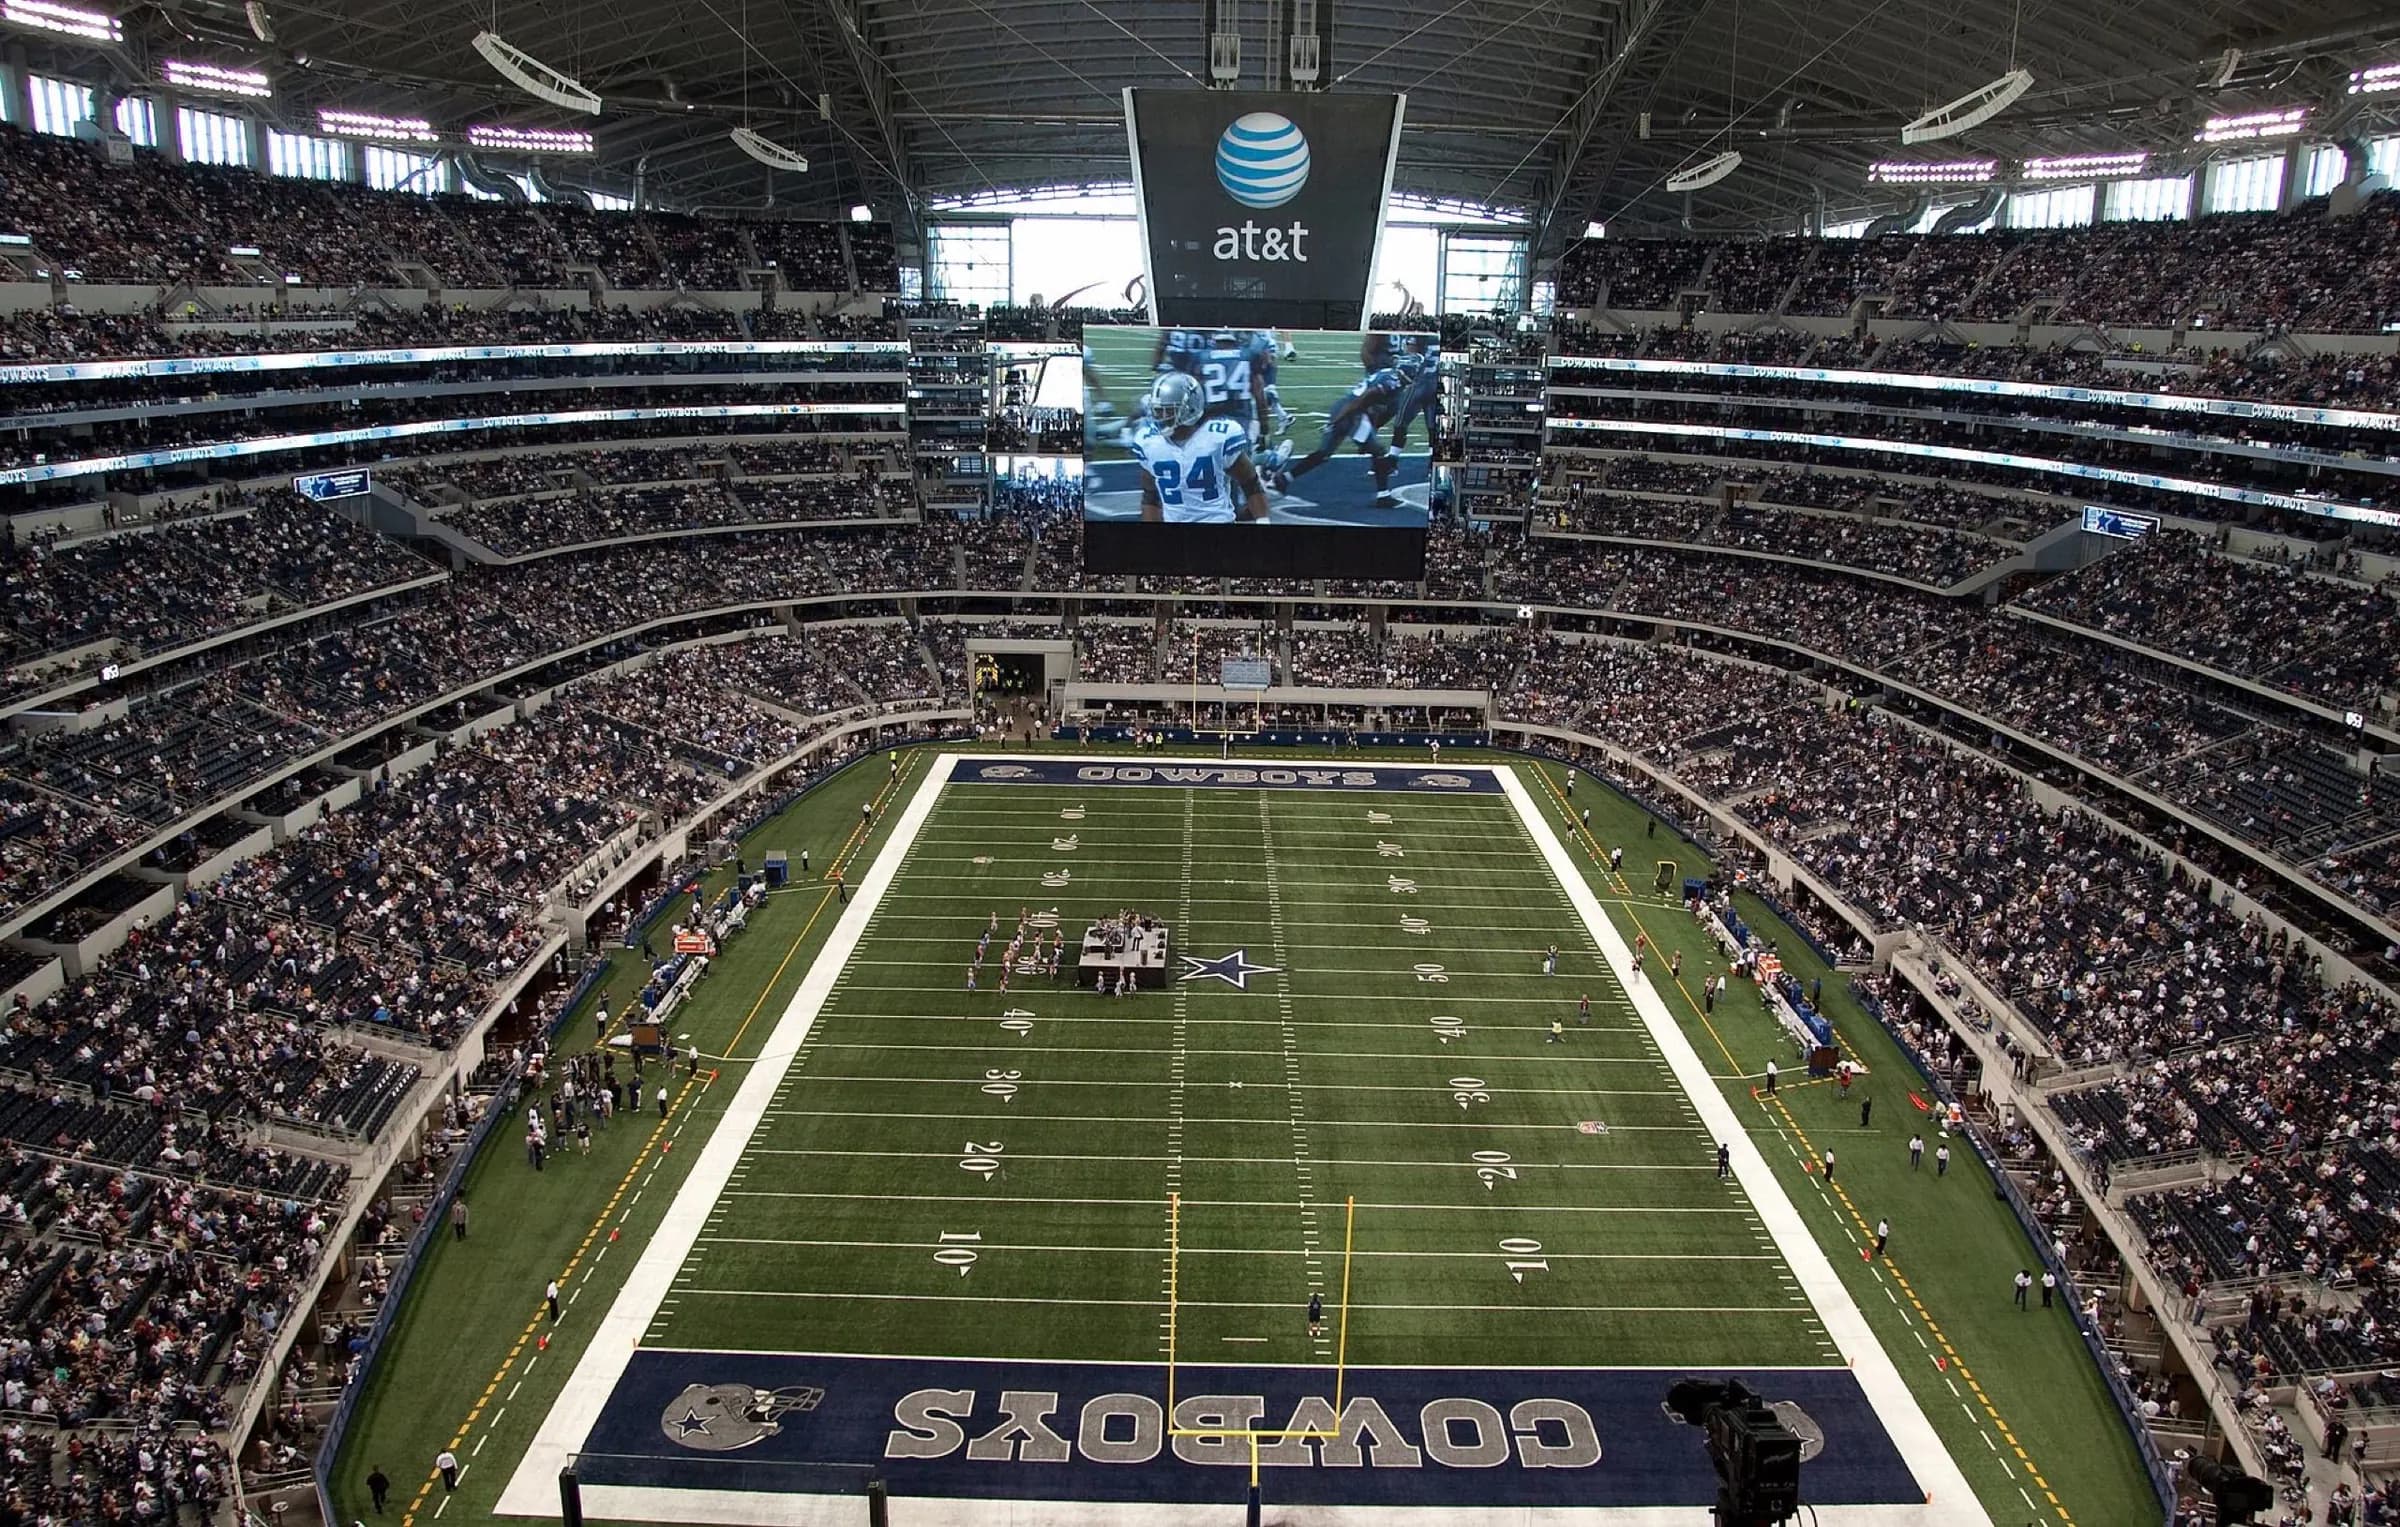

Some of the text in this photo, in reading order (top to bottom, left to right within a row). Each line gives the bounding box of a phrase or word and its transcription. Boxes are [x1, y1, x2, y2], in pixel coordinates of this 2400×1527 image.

[1212, 219, 1309, 262] at&t
[1202, 360, 1252, 403] 24
[2251, 404, 2298, 419] COWBOYS
[170, 448, 215, 463] COWBOYS
[1152, 455, 1219, 505] 24
[2262, 493, 2308, 511] COWBOYS
[1077, 766, 1377, 786] COWBOYS
[1041, 872, 1070, 887] 30
[1387, 878, 1418, 893] 30
[1029, 911, 1060, 928] 40
[1400, 918, 1431, 935] 40
[1413, 963, 1449, 983] 50
[1000, 1008, 1035, 1030] 40
[1430, 1016, 1467, 1038] 40
[981, 1069, 1021, 1094] 30
[1449, 1077, 1490, 1102] 30
[960, 1141, 1004, 1171] 20
[1472, 1151, 1517, 1179] 20
[933, 1230, 981, 1265] 10
[1499, 1238, 1550, 1272] 10
[884, 1388, 1602, 1468] COWBOYS
